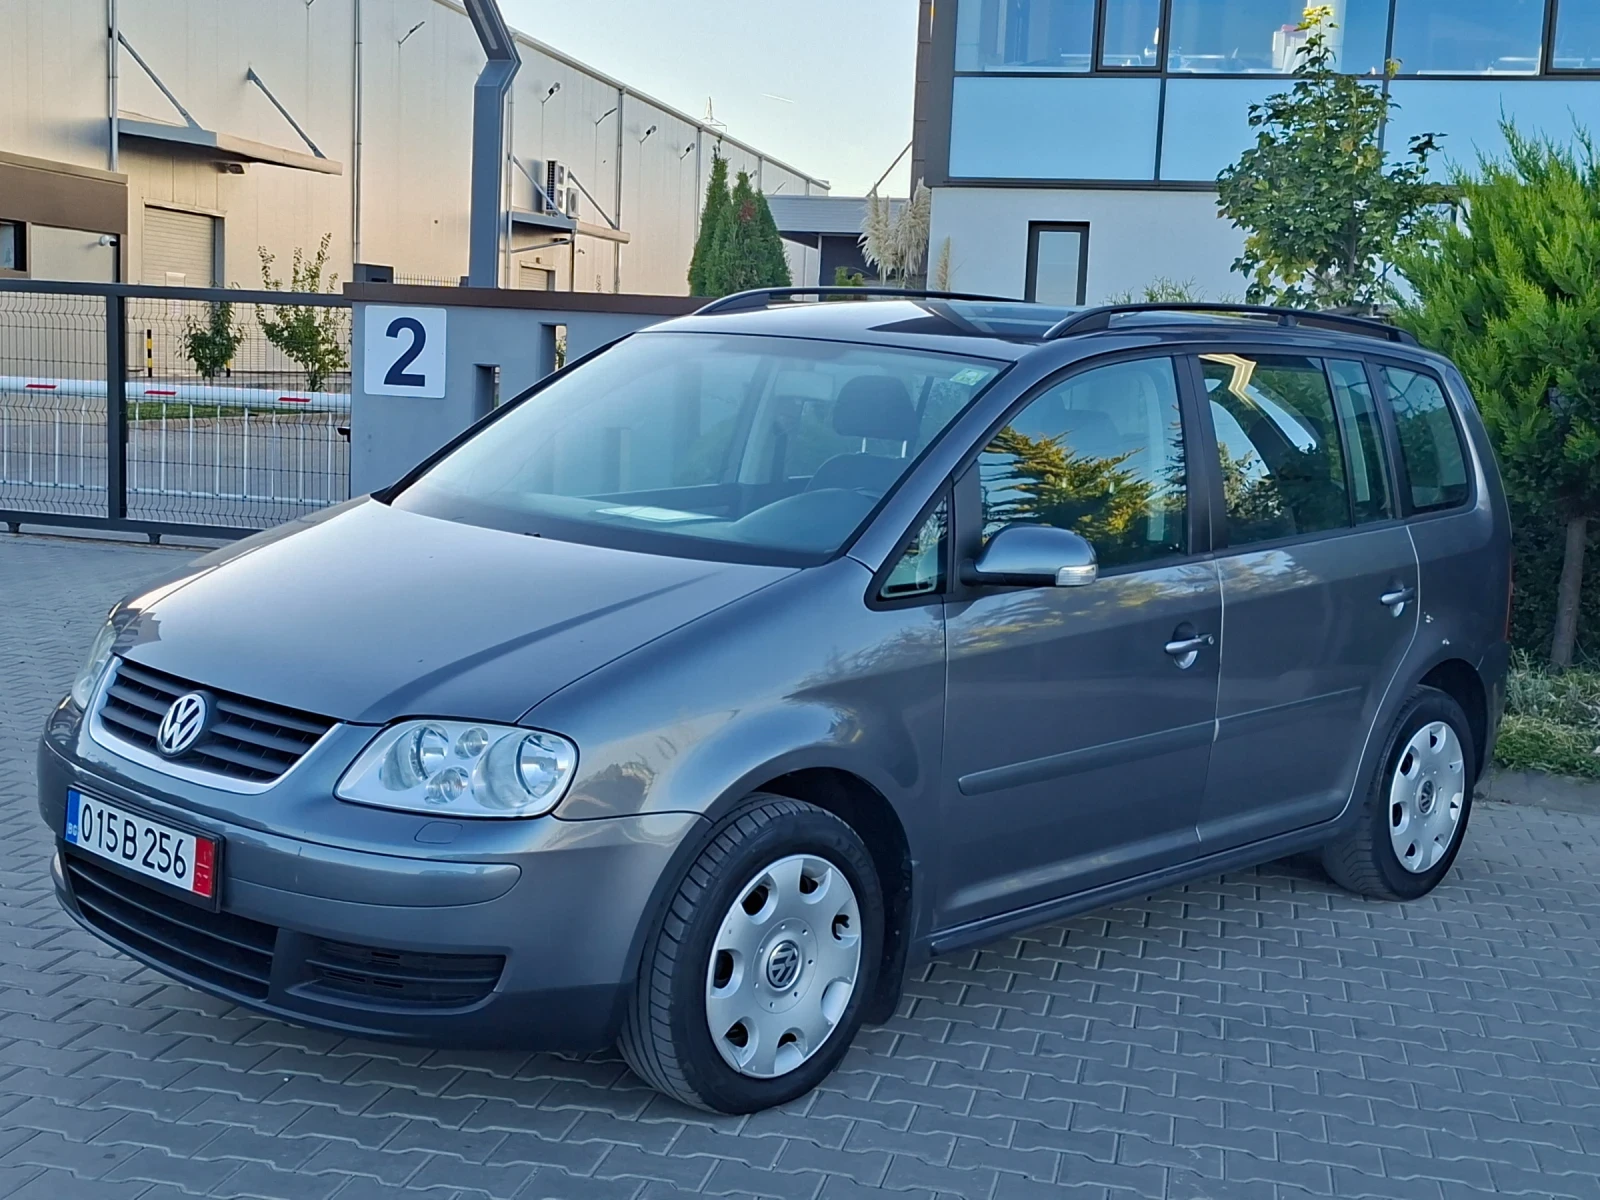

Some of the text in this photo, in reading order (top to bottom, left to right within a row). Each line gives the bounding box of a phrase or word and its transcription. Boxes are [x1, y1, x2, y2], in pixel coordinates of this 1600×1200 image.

[383, 316, 427, 387] 2
[159, 694, 206, 754] VW
[67, 822, 78, 837] BG
